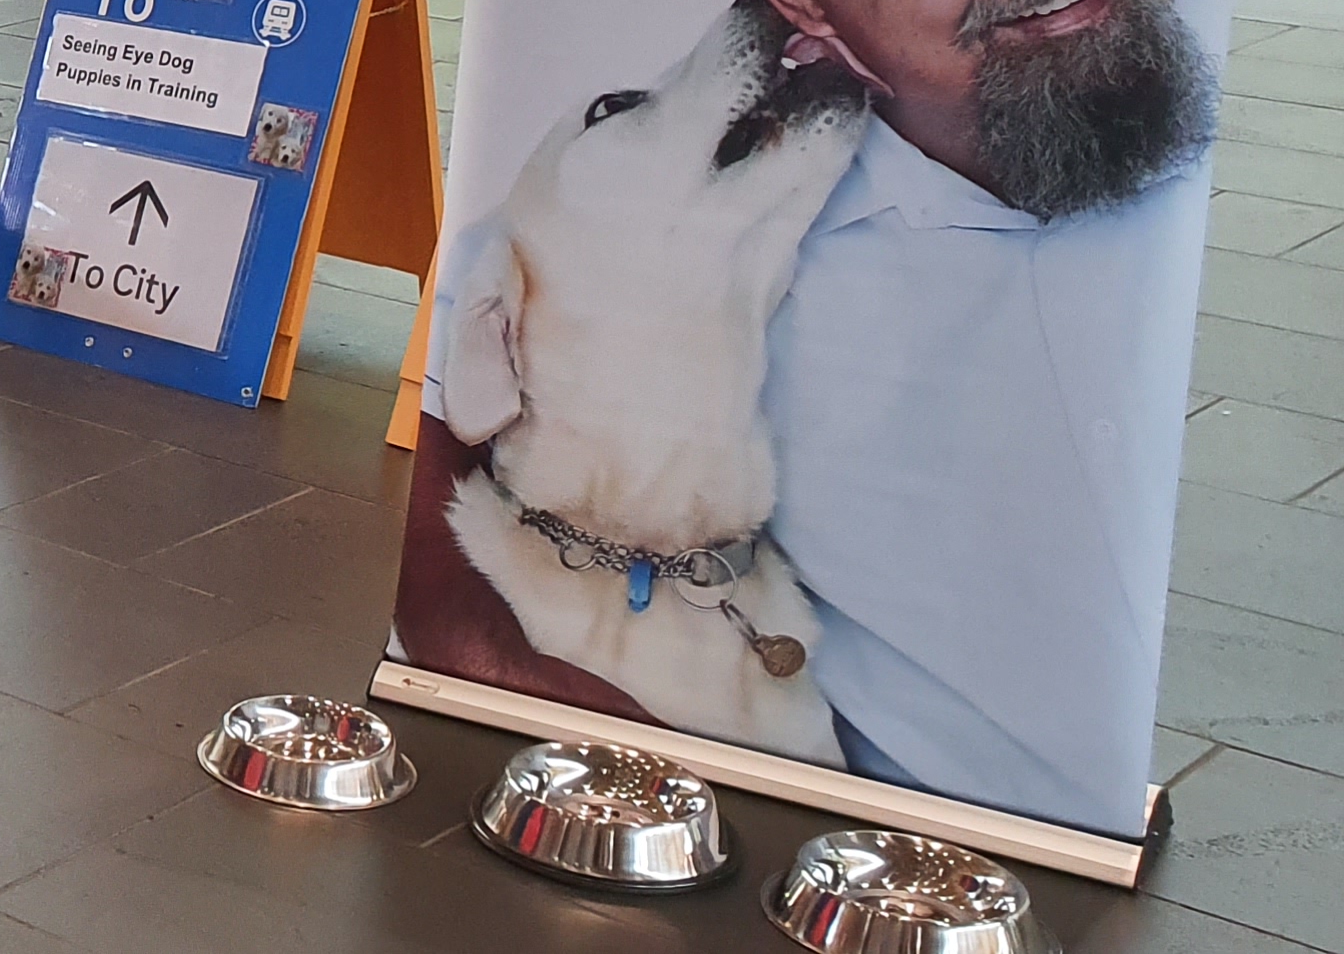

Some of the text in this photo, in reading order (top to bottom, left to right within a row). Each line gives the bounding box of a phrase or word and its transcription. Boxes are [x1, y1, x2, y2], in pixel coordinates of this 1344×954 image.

[62, 34, 194, 75] Seeing Eye Dog
[55, 61, 219, 109] Puppies in Training
[65, 250, 180, 315] To City
